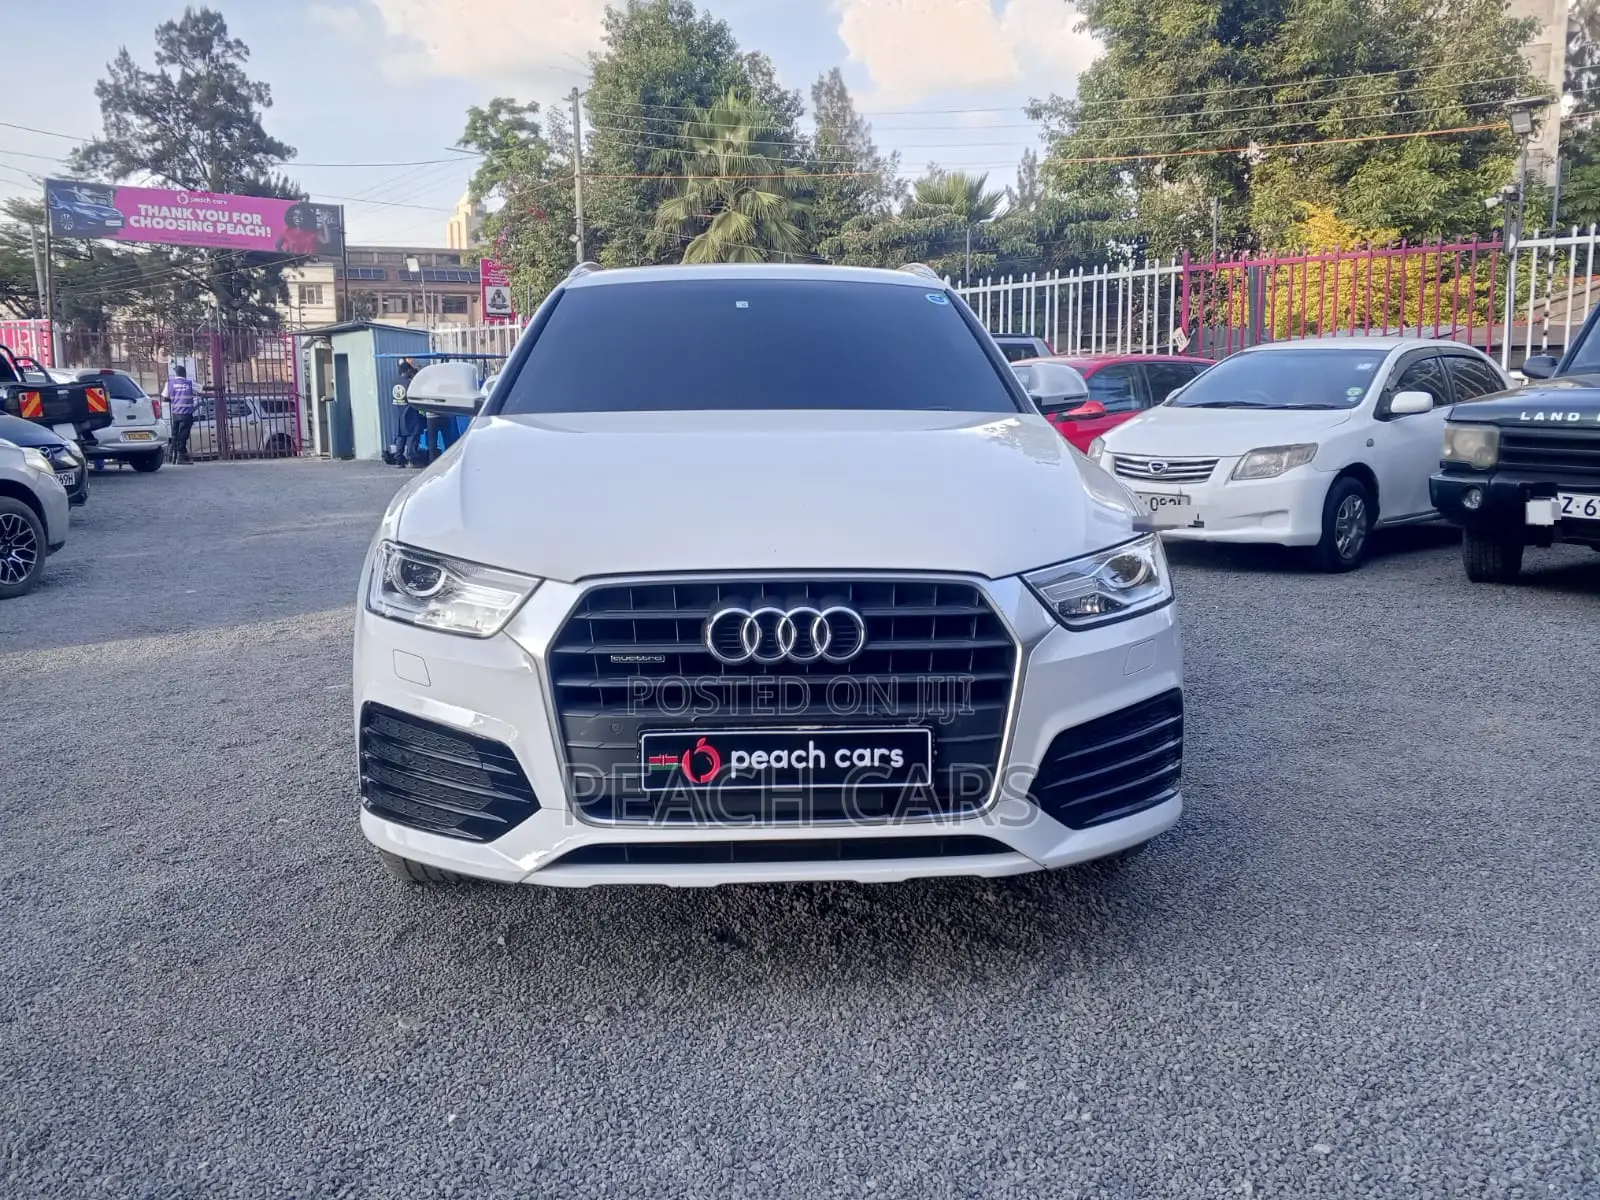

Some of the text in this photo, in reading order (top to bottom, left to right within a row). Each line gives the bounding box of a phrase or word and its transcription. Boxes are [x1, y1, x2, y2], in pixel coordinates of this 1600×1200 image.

[138, 204, 263, 226] THANK YOU FOR
[129, 215, 272, 238] CHOOSING PEACH!
[1520, 411, 1580, 421] LAND
[731, 740, 905, 778] peach cars
